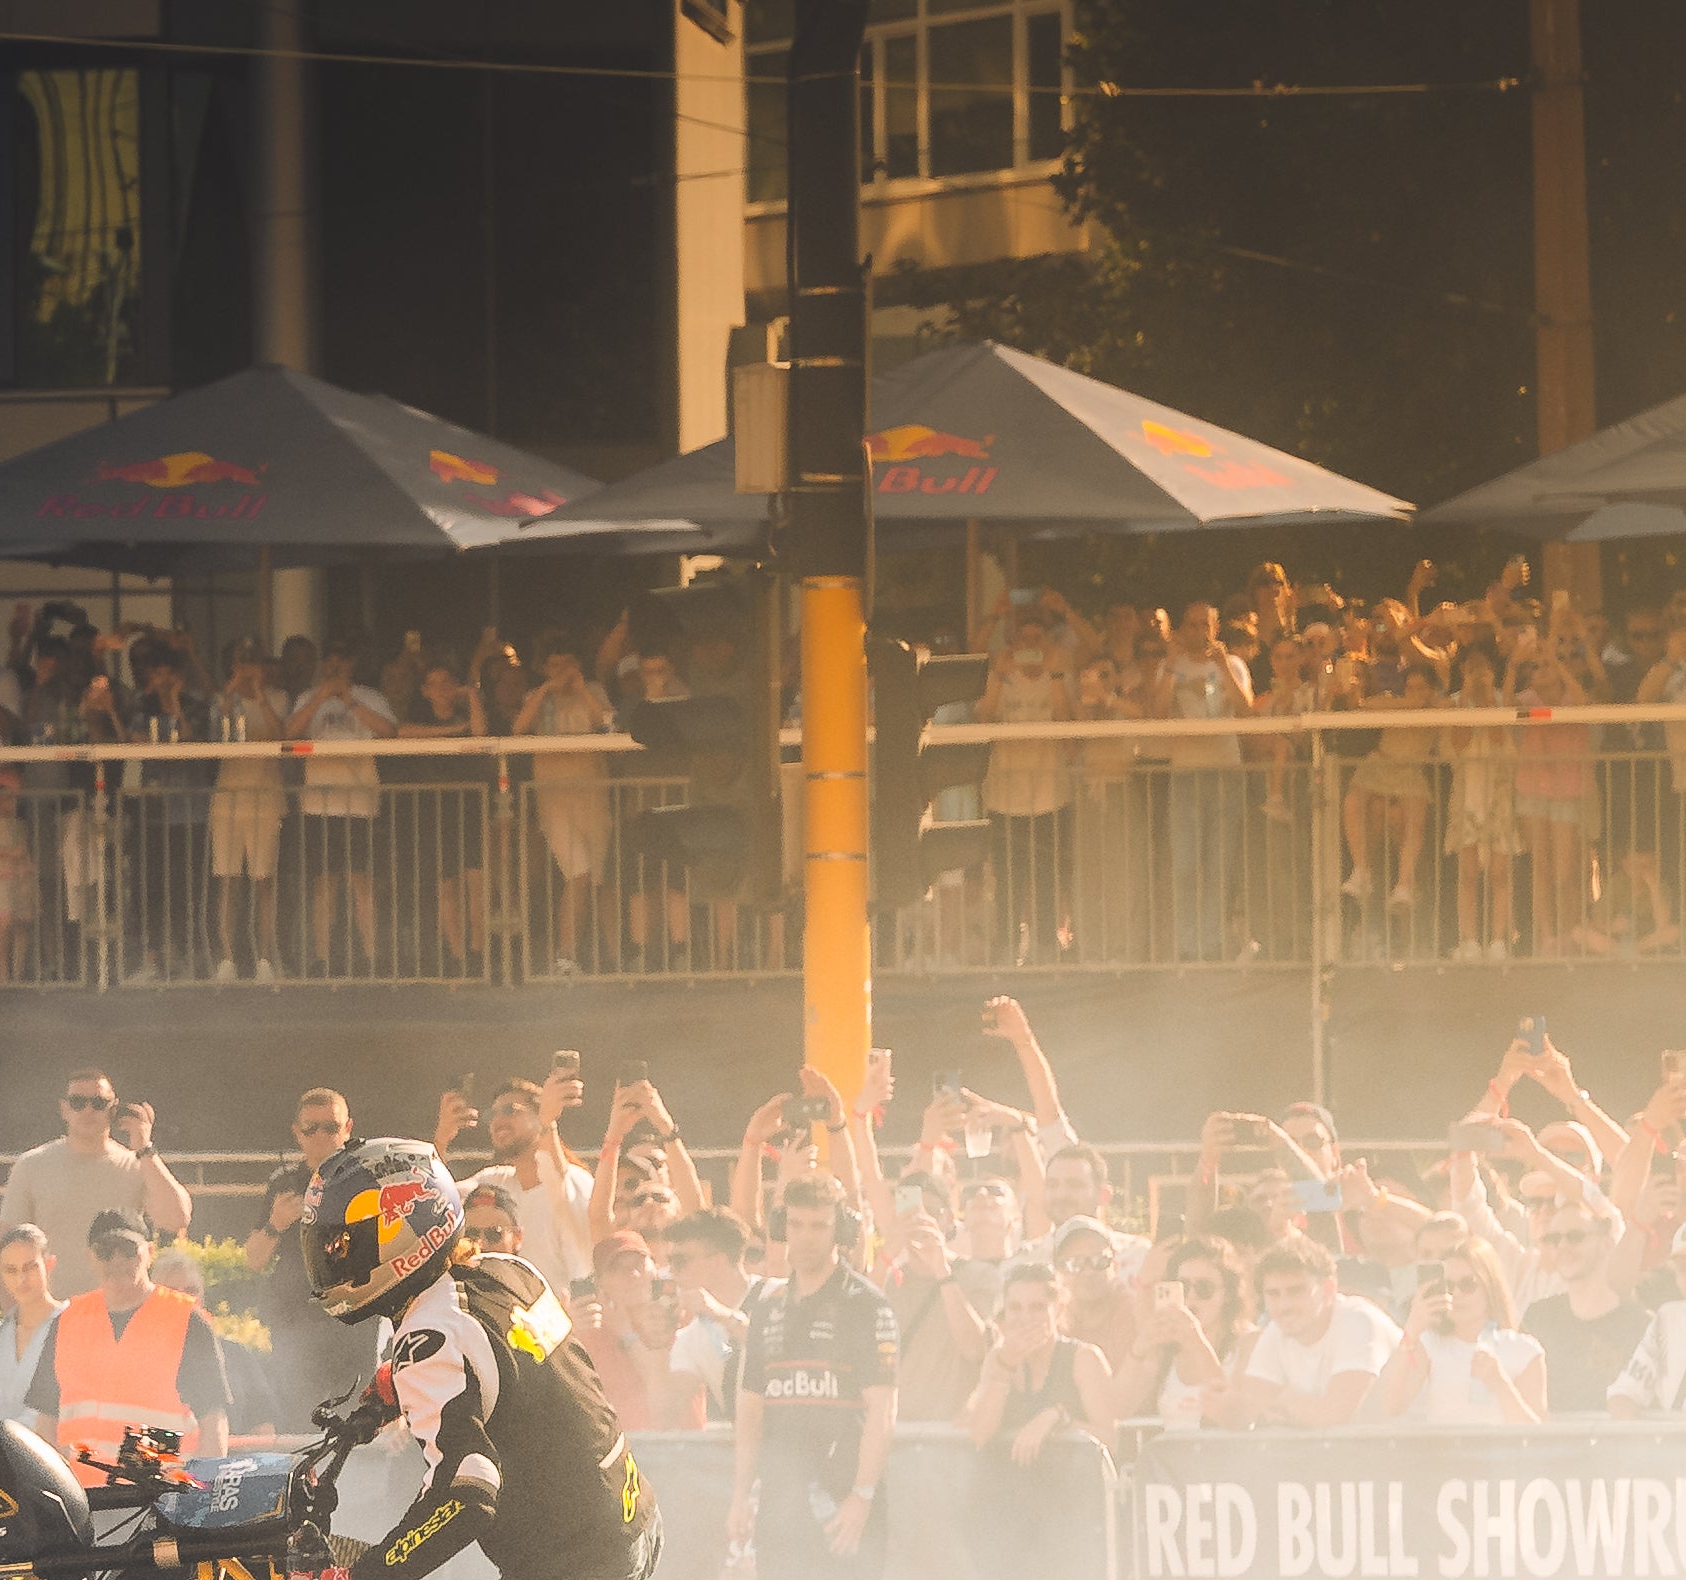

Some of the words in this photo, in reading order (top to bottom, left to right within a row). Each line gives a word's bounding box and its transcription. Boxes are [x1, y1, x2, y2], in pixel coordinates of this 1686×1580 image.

[877, 465, 1000, 496] Bull
[36, 494, 153, 520] Red
[152, 493, 268, 520] Bull
[390, 1234, 434, 1279] Red
[1145, 1481, 1257, 1578] RED
[1277, 1480, 1419, 1578] BULL
